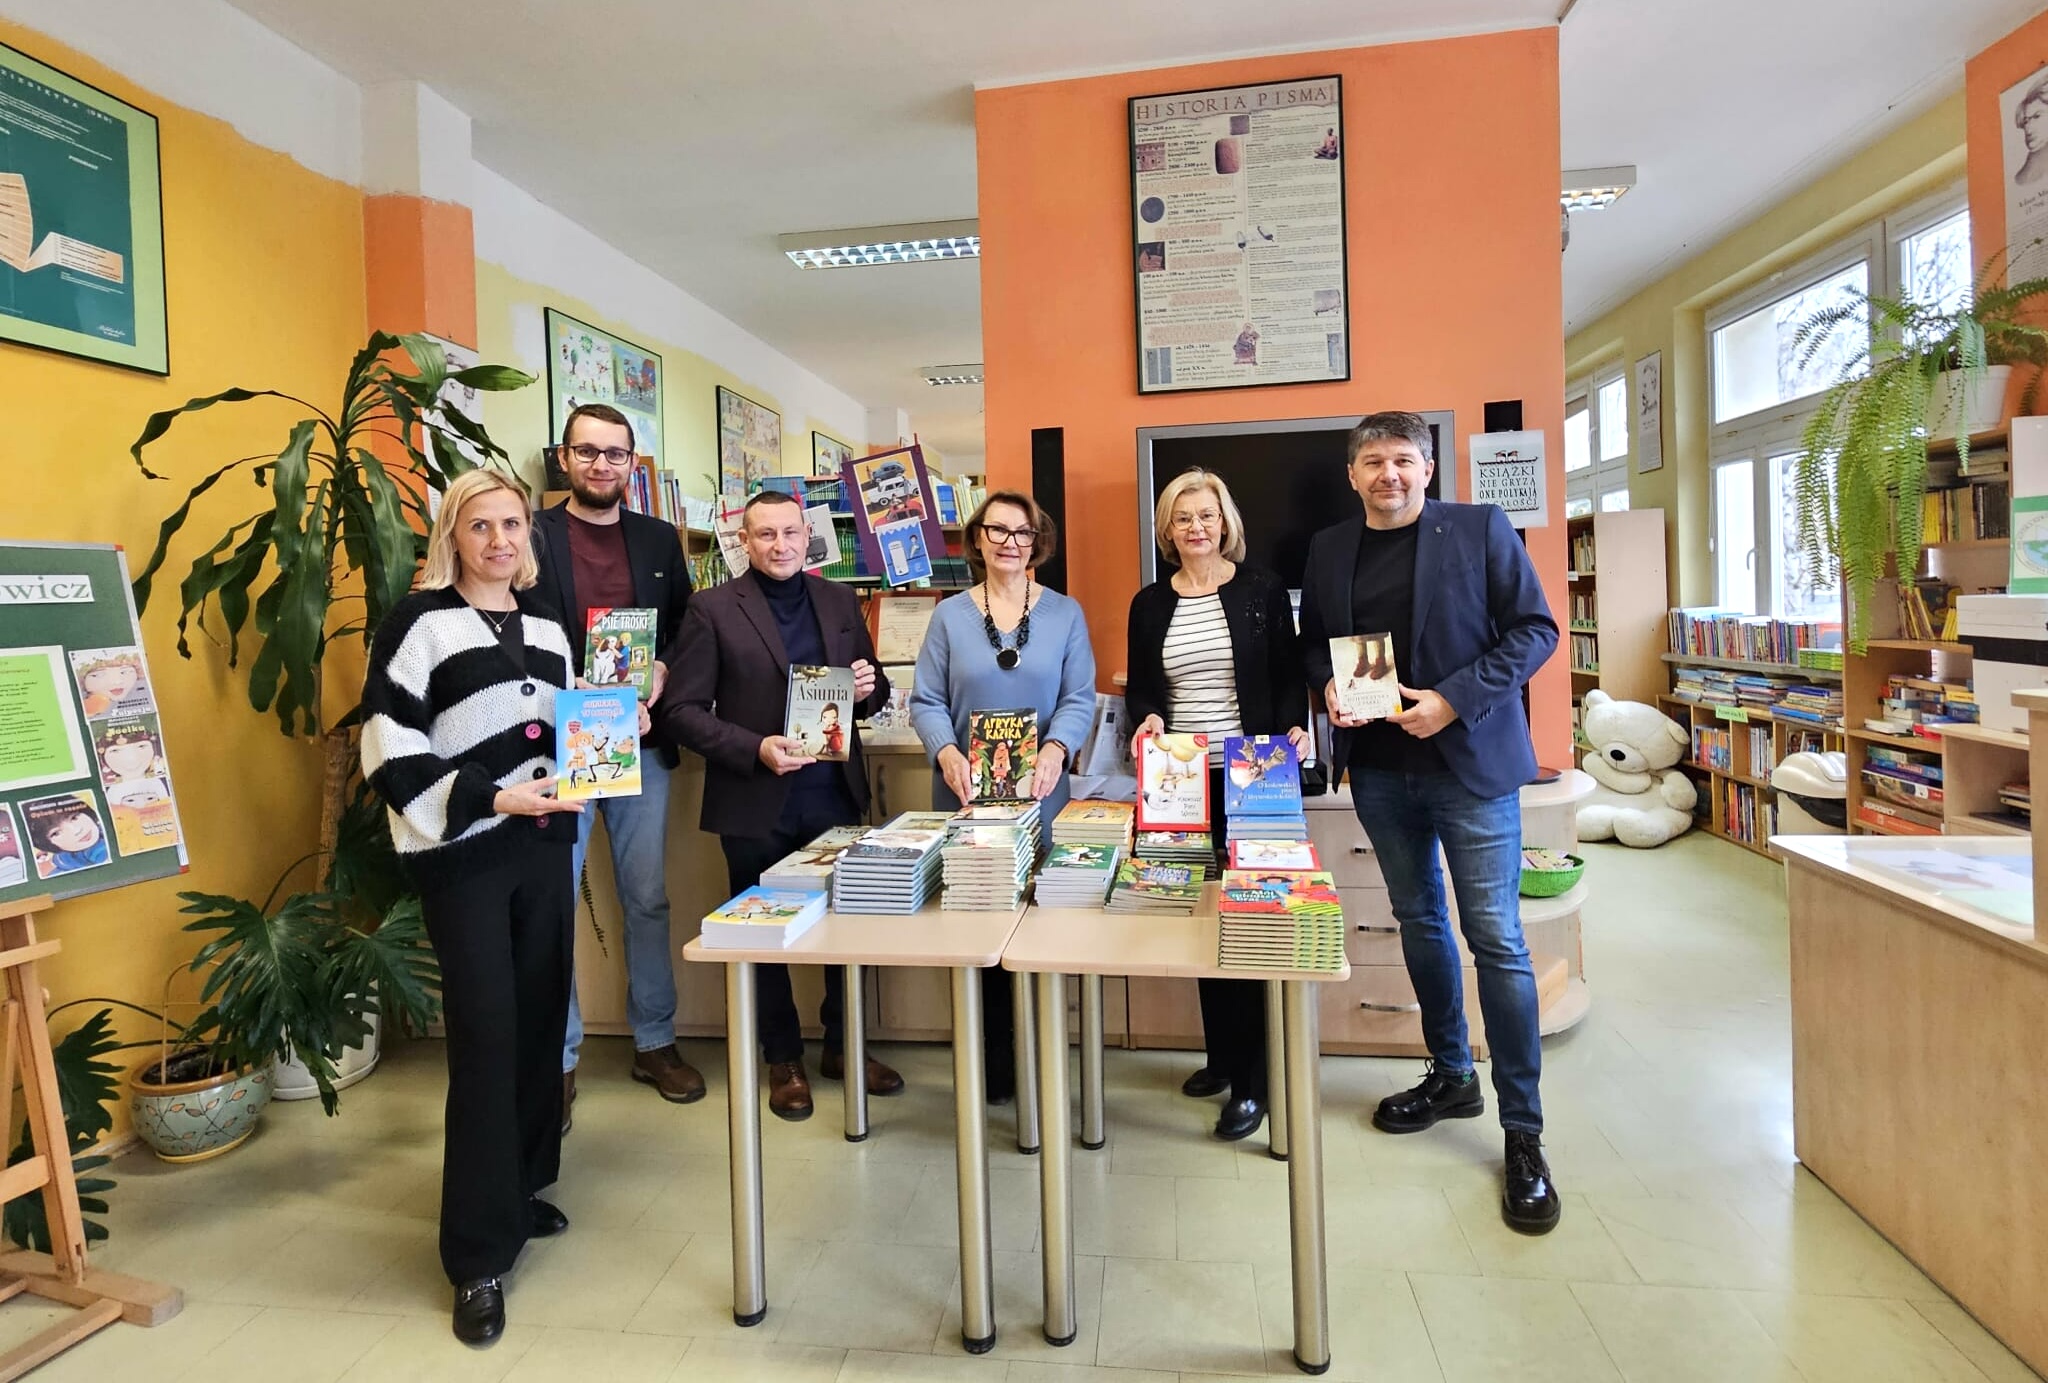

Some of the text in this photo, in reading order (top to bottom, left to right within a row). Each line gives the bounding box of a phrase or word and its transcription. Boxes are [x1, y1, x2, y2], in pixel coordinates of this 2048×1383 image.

[1136, 96, 1247, 120] HISTORIA
[1259, 87, 1328, 107] PISMA
[1480, 466, 1535, 478] KSIĄŻKI
[1480, 479, 1498, 488] NIE
[1480, 489, 1496, 499] ONE
[0, 575, 89, 600] wicz
[602, 616, 648, 630] PSIE TROSKI
[1585, 662, 1592, 670] N
[797, 683, 848, 701] Asiunia
[983, 717, 1024, 729] AFRYKA
[986, 728, 1022, 740] KAZIKA
